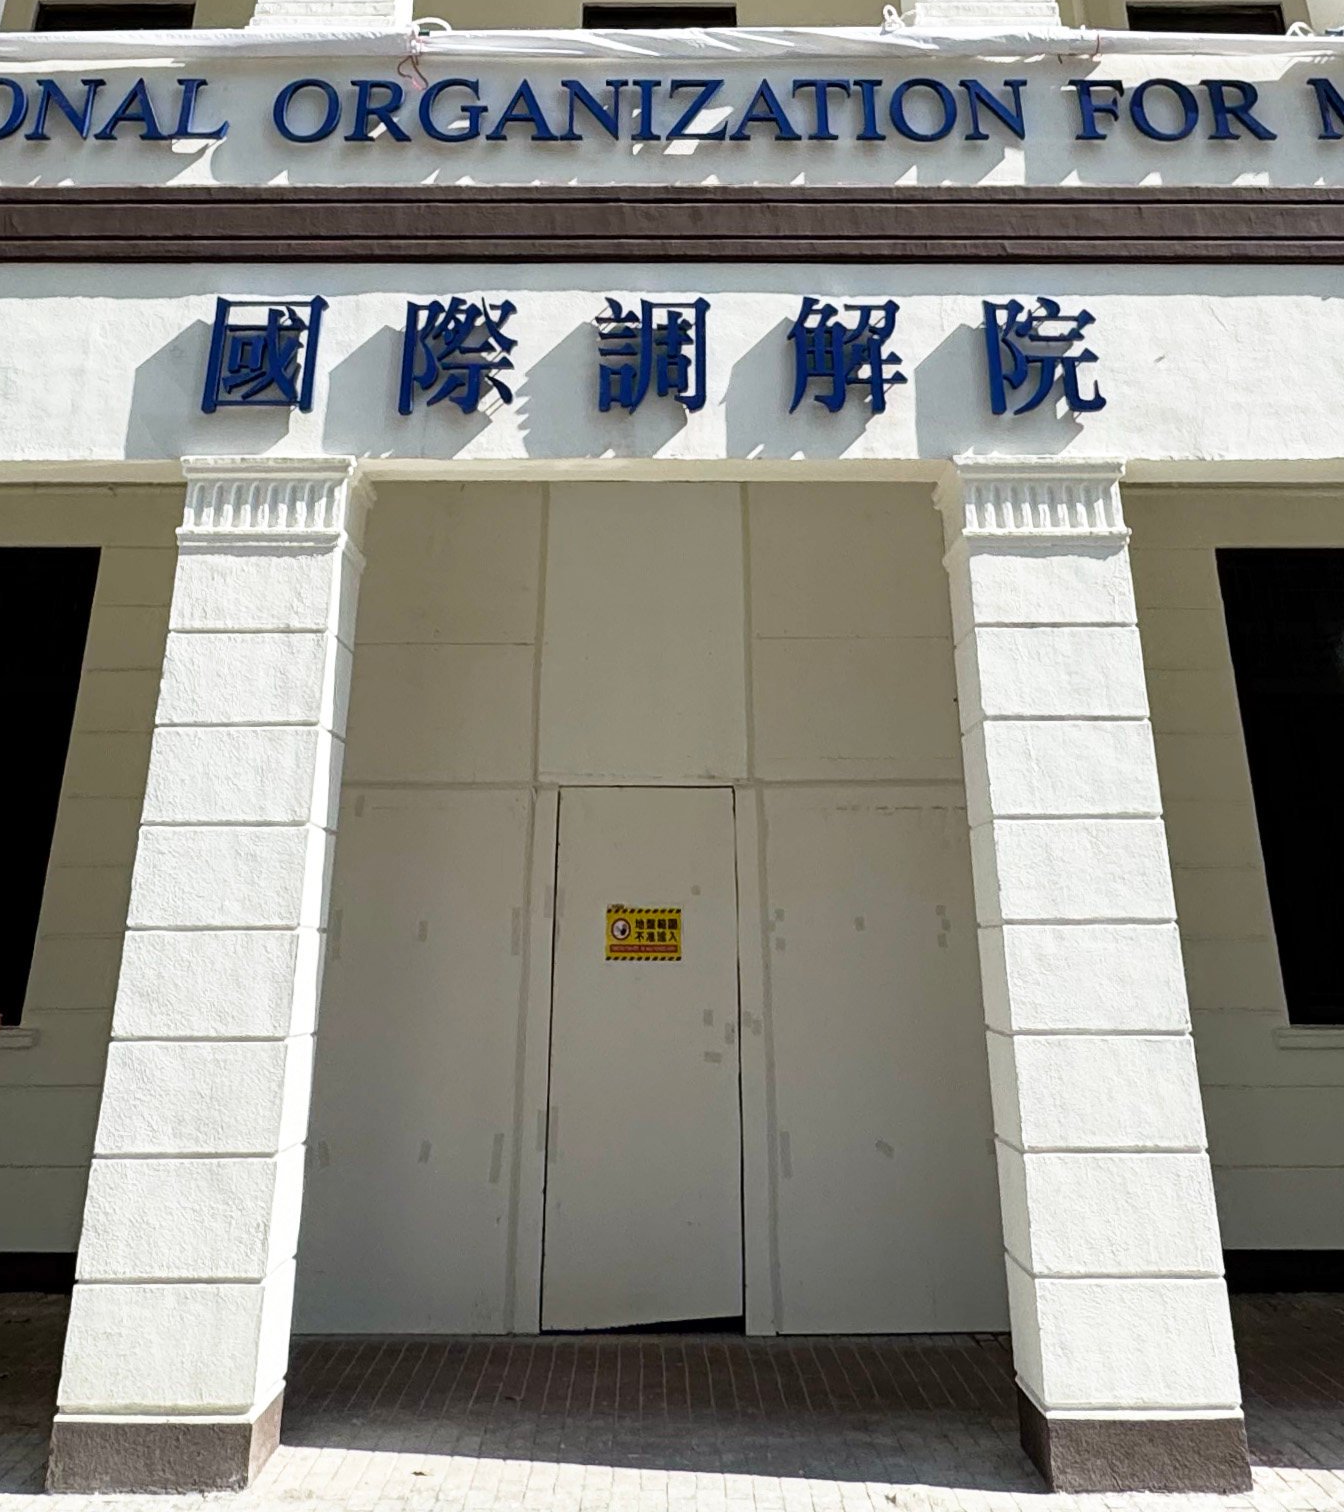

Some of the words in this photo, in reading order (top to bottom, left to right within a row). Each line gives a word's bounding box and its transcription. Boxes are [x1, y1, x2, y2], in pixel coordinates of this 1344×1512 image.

[271, 77, 1027, 142] ORGANIZATION
[1068, 77, 1277, 141] FOR
[201, 296, 1106, 414] 國際調解院
